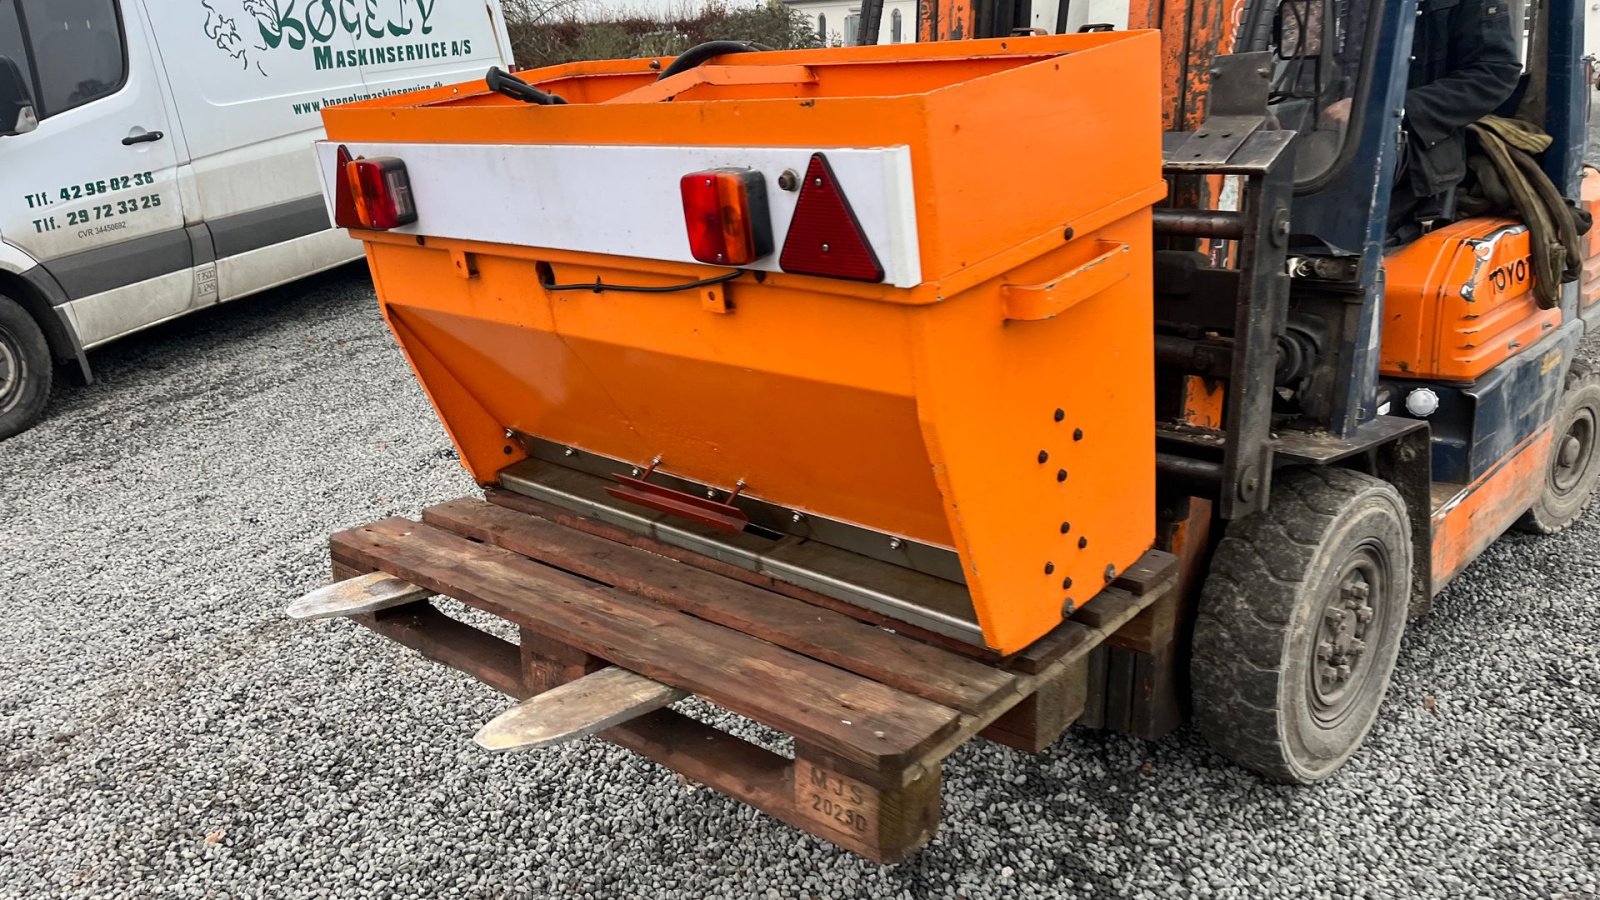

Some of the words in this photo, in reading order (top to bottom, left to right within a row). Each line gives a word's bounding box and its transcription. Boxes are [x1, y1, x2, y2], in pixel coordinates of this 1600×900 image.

[451, 39, 472, 57] A/S
[24, 192, 53, 208] Tlf.
[60, 187, 81, 201] 42
[85, 181, 107, 196] 96
[110, 175, 131, 191] 02
[133, 171, 155, 185] 38
[32, 216, 61, 233] Tlf.
[67, 209, 90, 226] 29
[93, 203, 114, 220] 72
[117, 198, 139, 214] 33
[140, 193, 162, 209] 25
[77, 229, 94, 238] CVR
